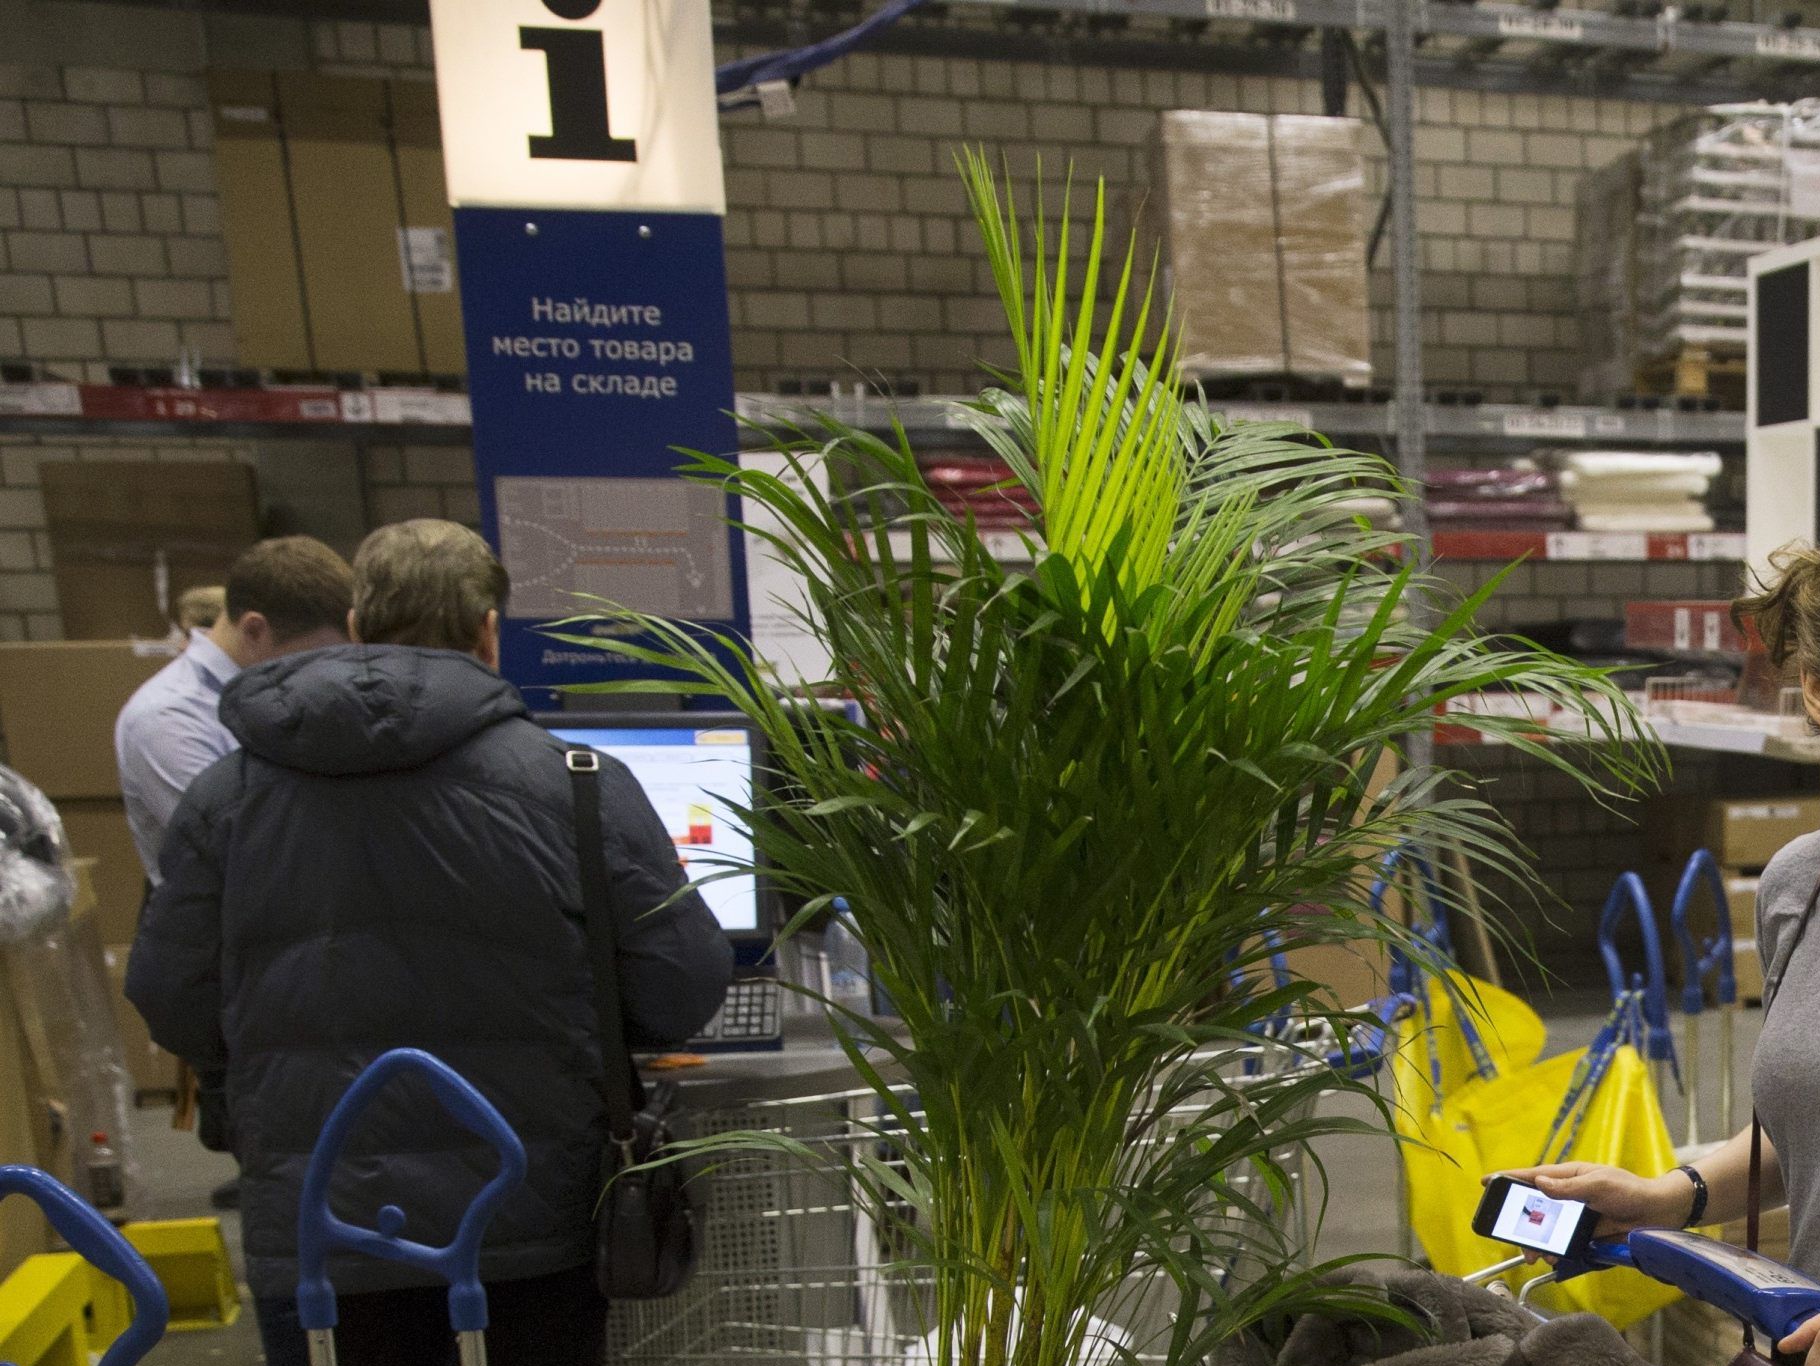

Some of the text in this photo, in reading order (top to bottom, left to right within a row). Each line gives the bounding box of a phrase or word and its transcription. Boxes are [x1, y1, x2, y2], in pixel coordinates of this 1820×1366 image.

[518, 0, 638, 162] i
[531, 297, 662, 328] Найдите
[492, 336, 695, 367] место товара
[524, 372, 678, 400] на складе
